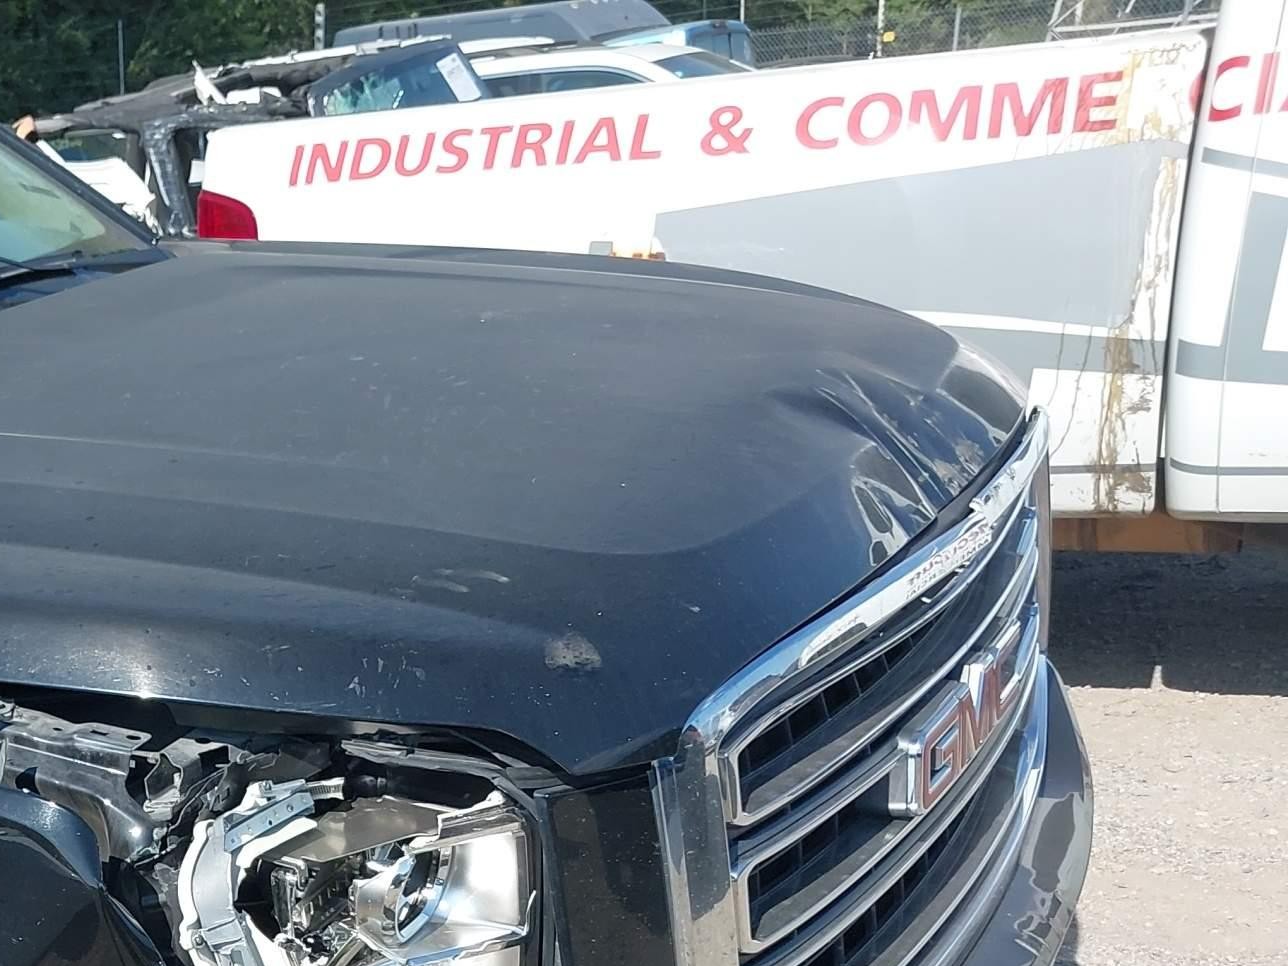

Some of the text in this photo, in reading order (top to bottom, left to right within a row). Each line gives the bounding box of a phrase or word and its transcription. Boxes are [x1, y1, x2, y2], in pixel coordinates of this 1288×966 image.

[288, 113, 662, 188] INDUSTRIAL
[698, 105, 751, 155] &
[918, 632, 1023, 812] GMC
